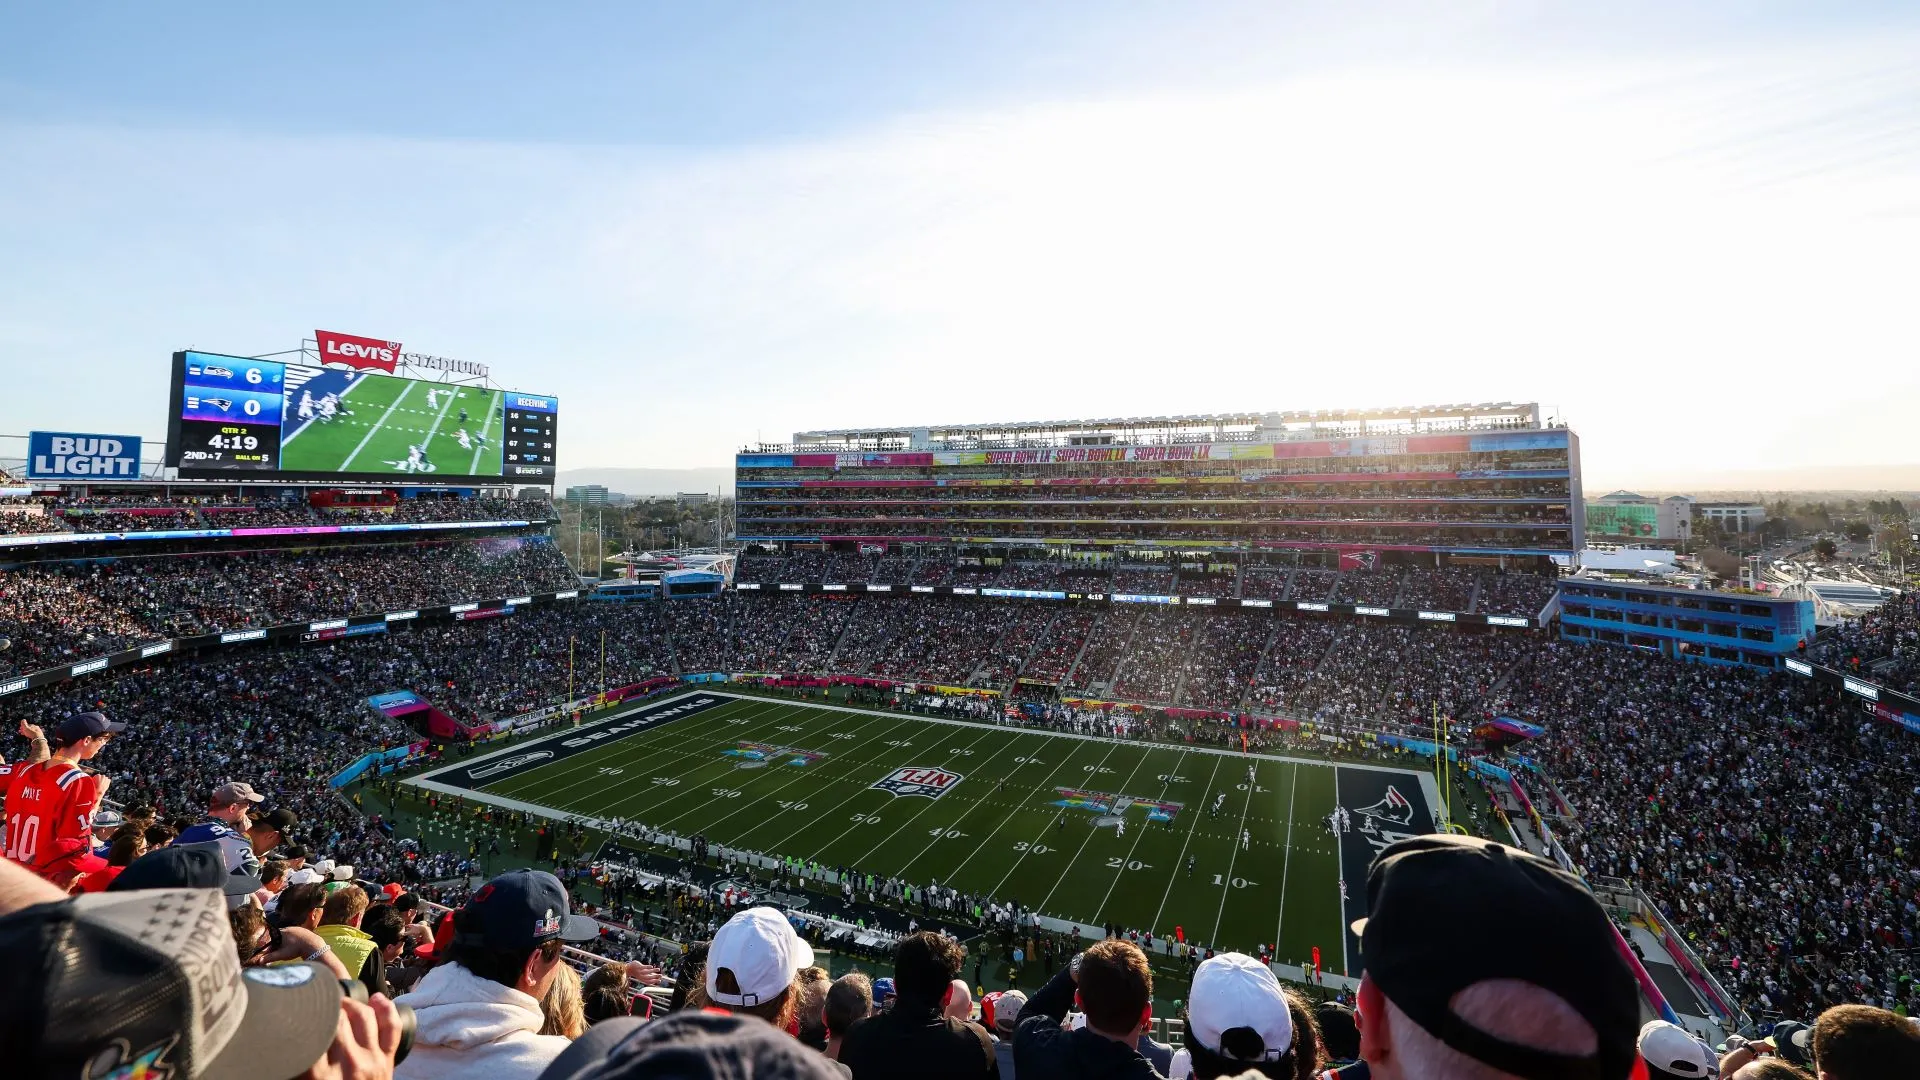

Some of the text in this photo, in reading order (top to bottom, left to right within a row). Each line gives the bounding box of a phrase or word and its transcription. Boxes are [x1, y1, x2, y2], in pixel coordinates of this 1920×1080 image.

[405, 352, 487, 377] STADIUM
[245, 368, 262, 384] 6
[244, 400, 261, 416] 0
[517, 397, 548, 409] RECEIVING
[52, 437, 123, 457] BUD
[208, 435, 258, 450] 4:19
[184, 451, 207, 460] 2ND
[214, 452, 222, 460] 7
[262, 454, 269, 462] 5
[984, 452, 1013, 464] SUPER
[1014, 451, 1038, 463] BOWL
[1056, 450, 1085, 463] SUPER
[1087, 448, 1114, 462] BOWL
[1133, 447, 1165, 461] SUPER
[1167, 446, 1196, 460] BOWL
[35, 455, 135, 475] LIGHT
[1489, 617, 1527, 627] BUD LIGHT
[1845, 681, 1877, 698] BUD LIGHT
[561, 699, 716, 749] SEAHAWKS
[900, 769, 955, 787] NFL
[714, 788, 742, 798] 30
[780, 801, 808, 811] 40
[850, 813, 881, 825] 50
[7, 813, 40, 862] 10
[929, 827, 961, 839] 40
[1013, 842, 1048, 855] 30
[1106, 857, 1143, 871] 20
[1211, 874, 1248, 889] 10
